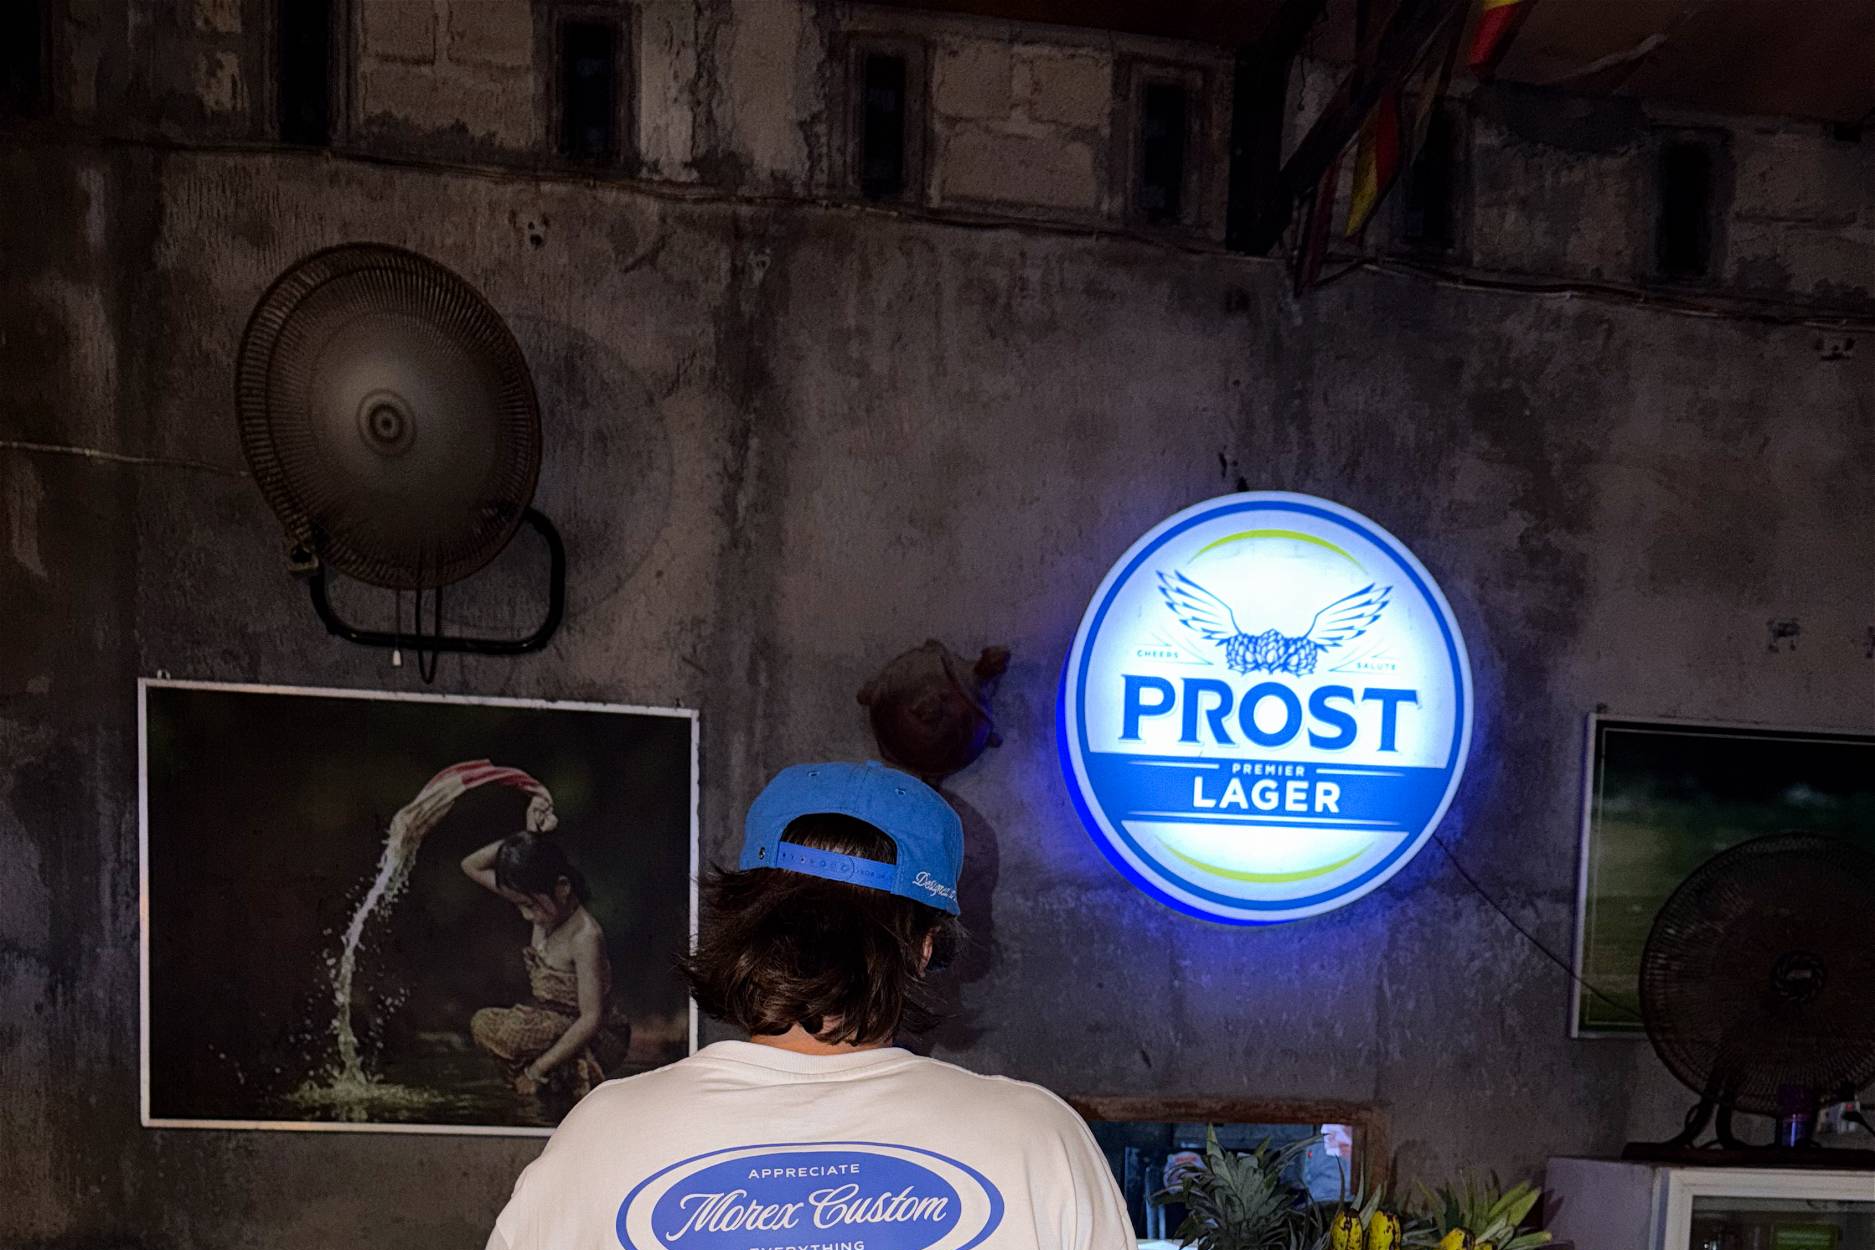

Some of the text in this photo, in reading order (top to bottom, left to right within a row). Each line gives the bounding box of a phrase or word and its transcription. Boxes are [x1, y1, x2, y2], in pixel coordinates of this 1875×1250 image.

[1356, 661, 1398, 672] SALUTE
[1118, 674, 1420, 753] PROST
[1231, 763, 1306, 777] PREMIER
[1192, 776, 1341, 814] LAGER
[748, 1163, 861, 1180] APPRECIATE
[665, 1183, 949, 1242] Morex Custom
